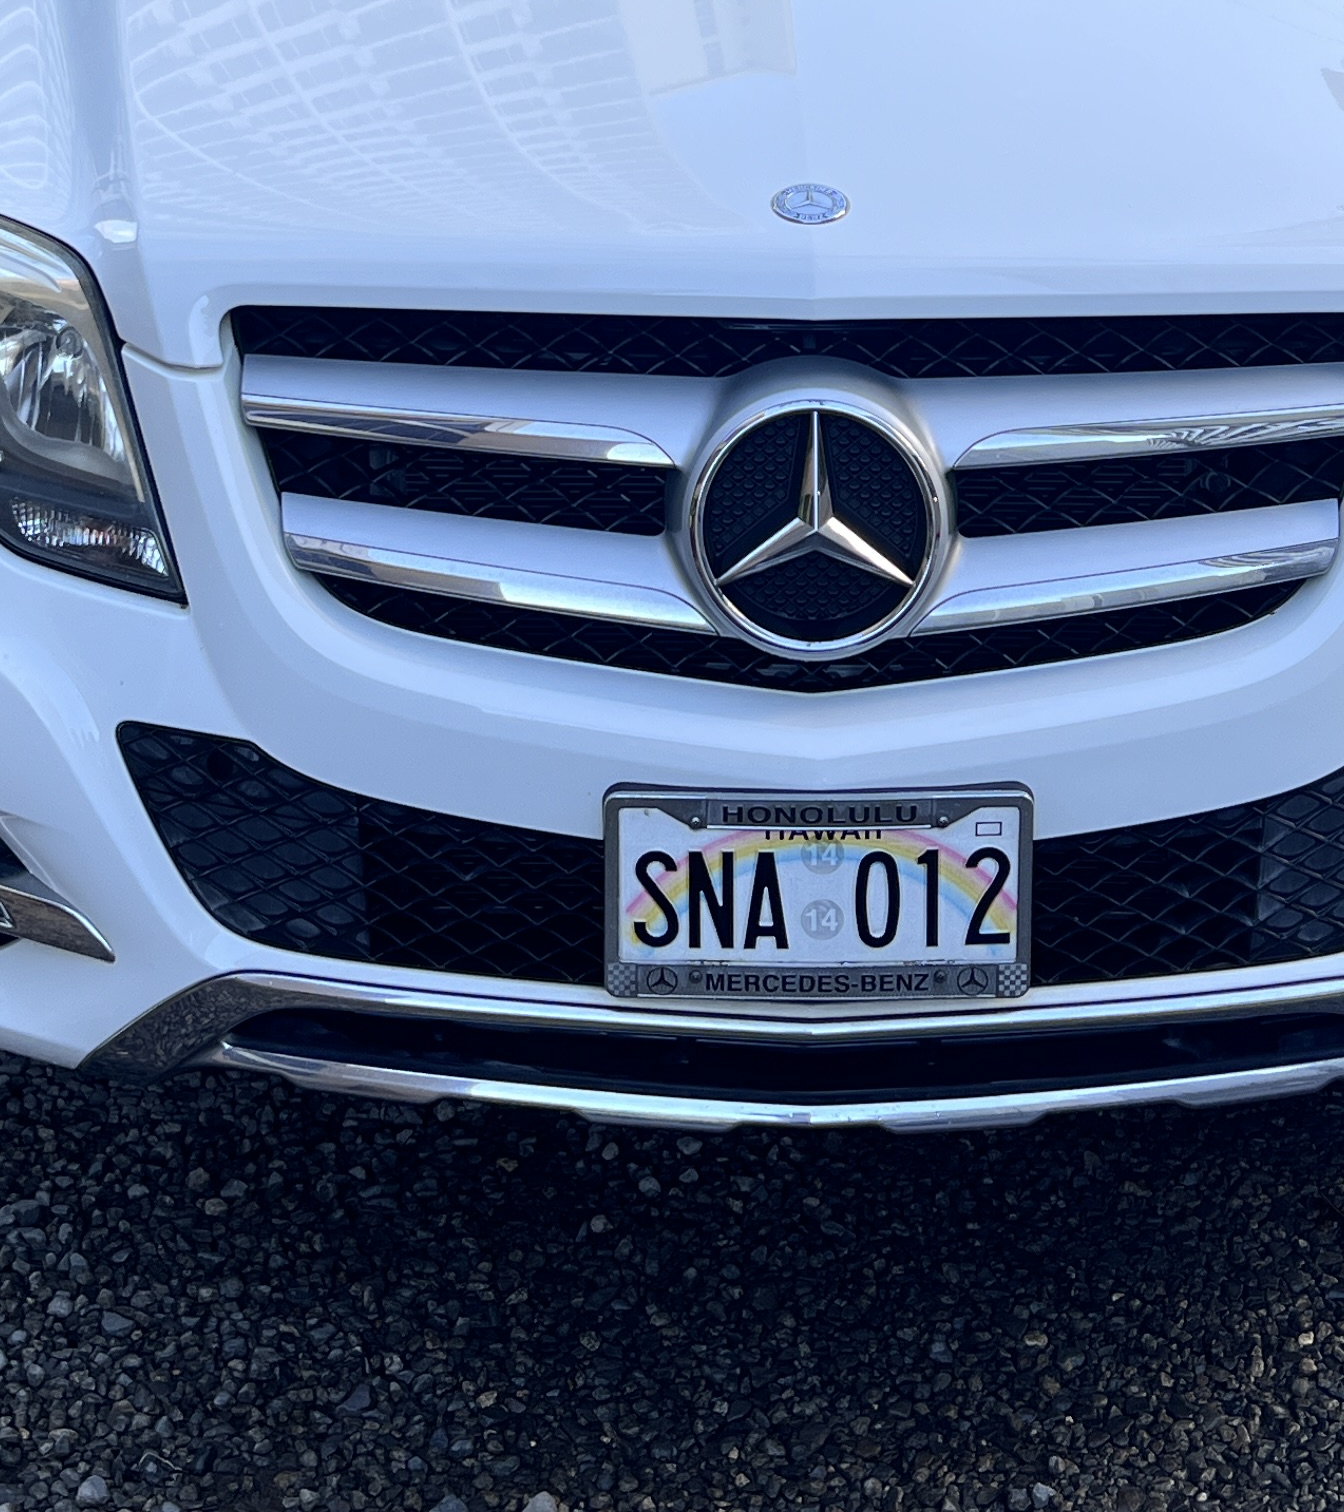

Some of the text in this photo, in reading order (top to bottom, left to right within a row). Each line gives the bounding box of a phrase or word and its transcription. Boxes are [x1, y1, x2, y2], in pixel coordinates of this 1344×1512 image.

[721, 804, 918, 825] HONOLULU
[805, 842, 838, 866] 14
[633, 846, 1012, 950] SNA 012
[805, 907, 838, 932] 14
[705, 972, 930, 994] MERCEDES-BENZ
